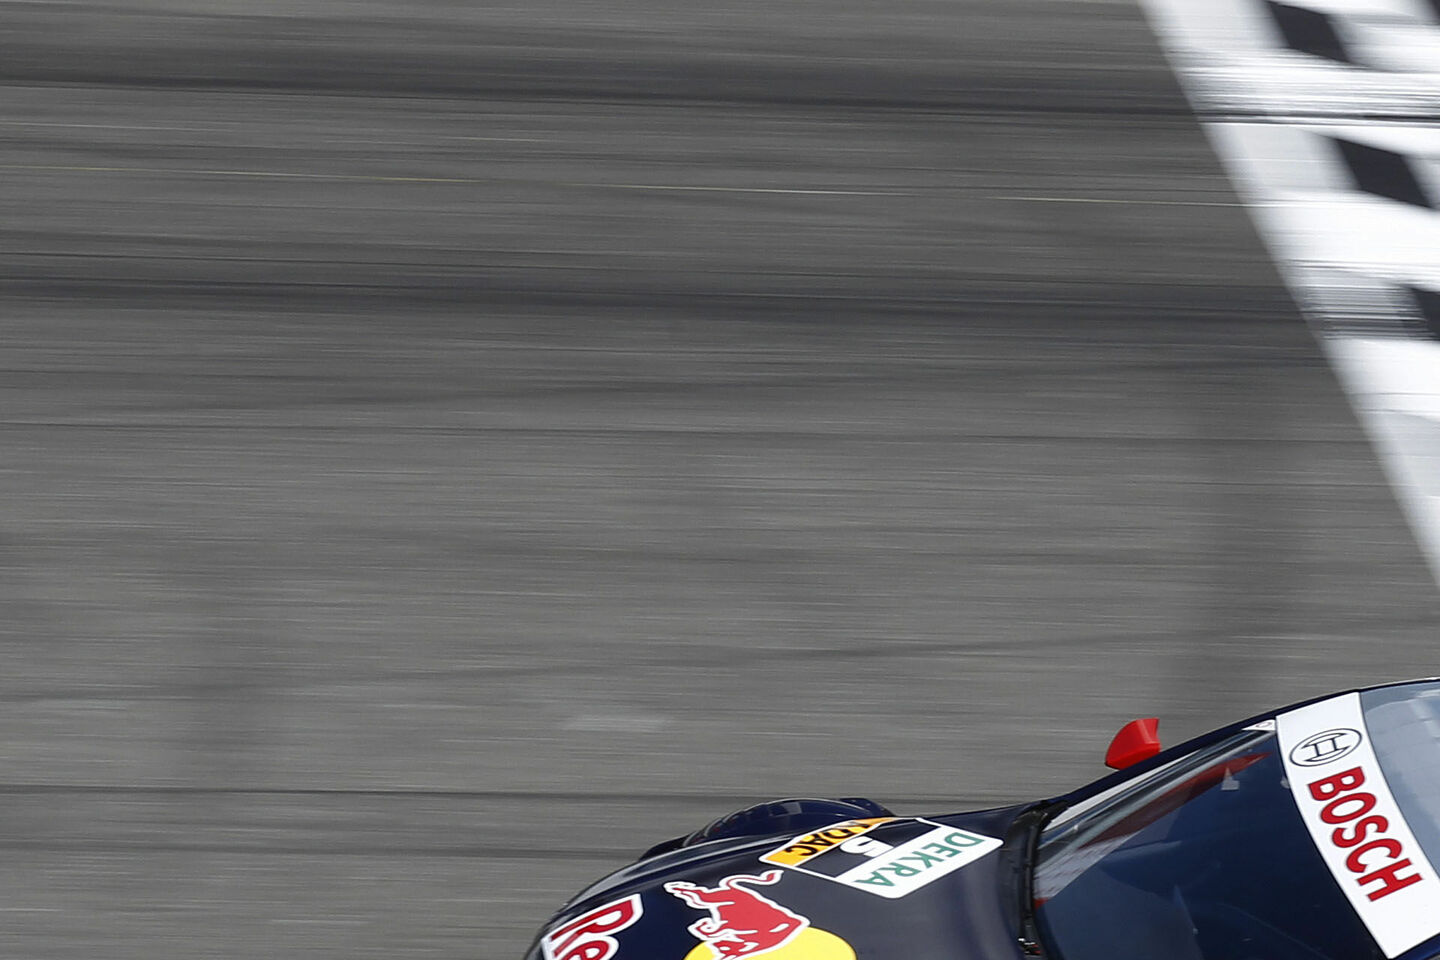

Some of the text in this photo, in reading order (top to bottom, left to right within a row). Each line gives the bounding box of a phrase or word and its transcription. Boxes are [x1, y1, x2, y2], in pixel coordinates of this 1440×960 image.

[840, 835, 895, 858] 5
[853, 831, 985, 887] DEKRA
[1307, 766, 1424, 902] BOSCH
